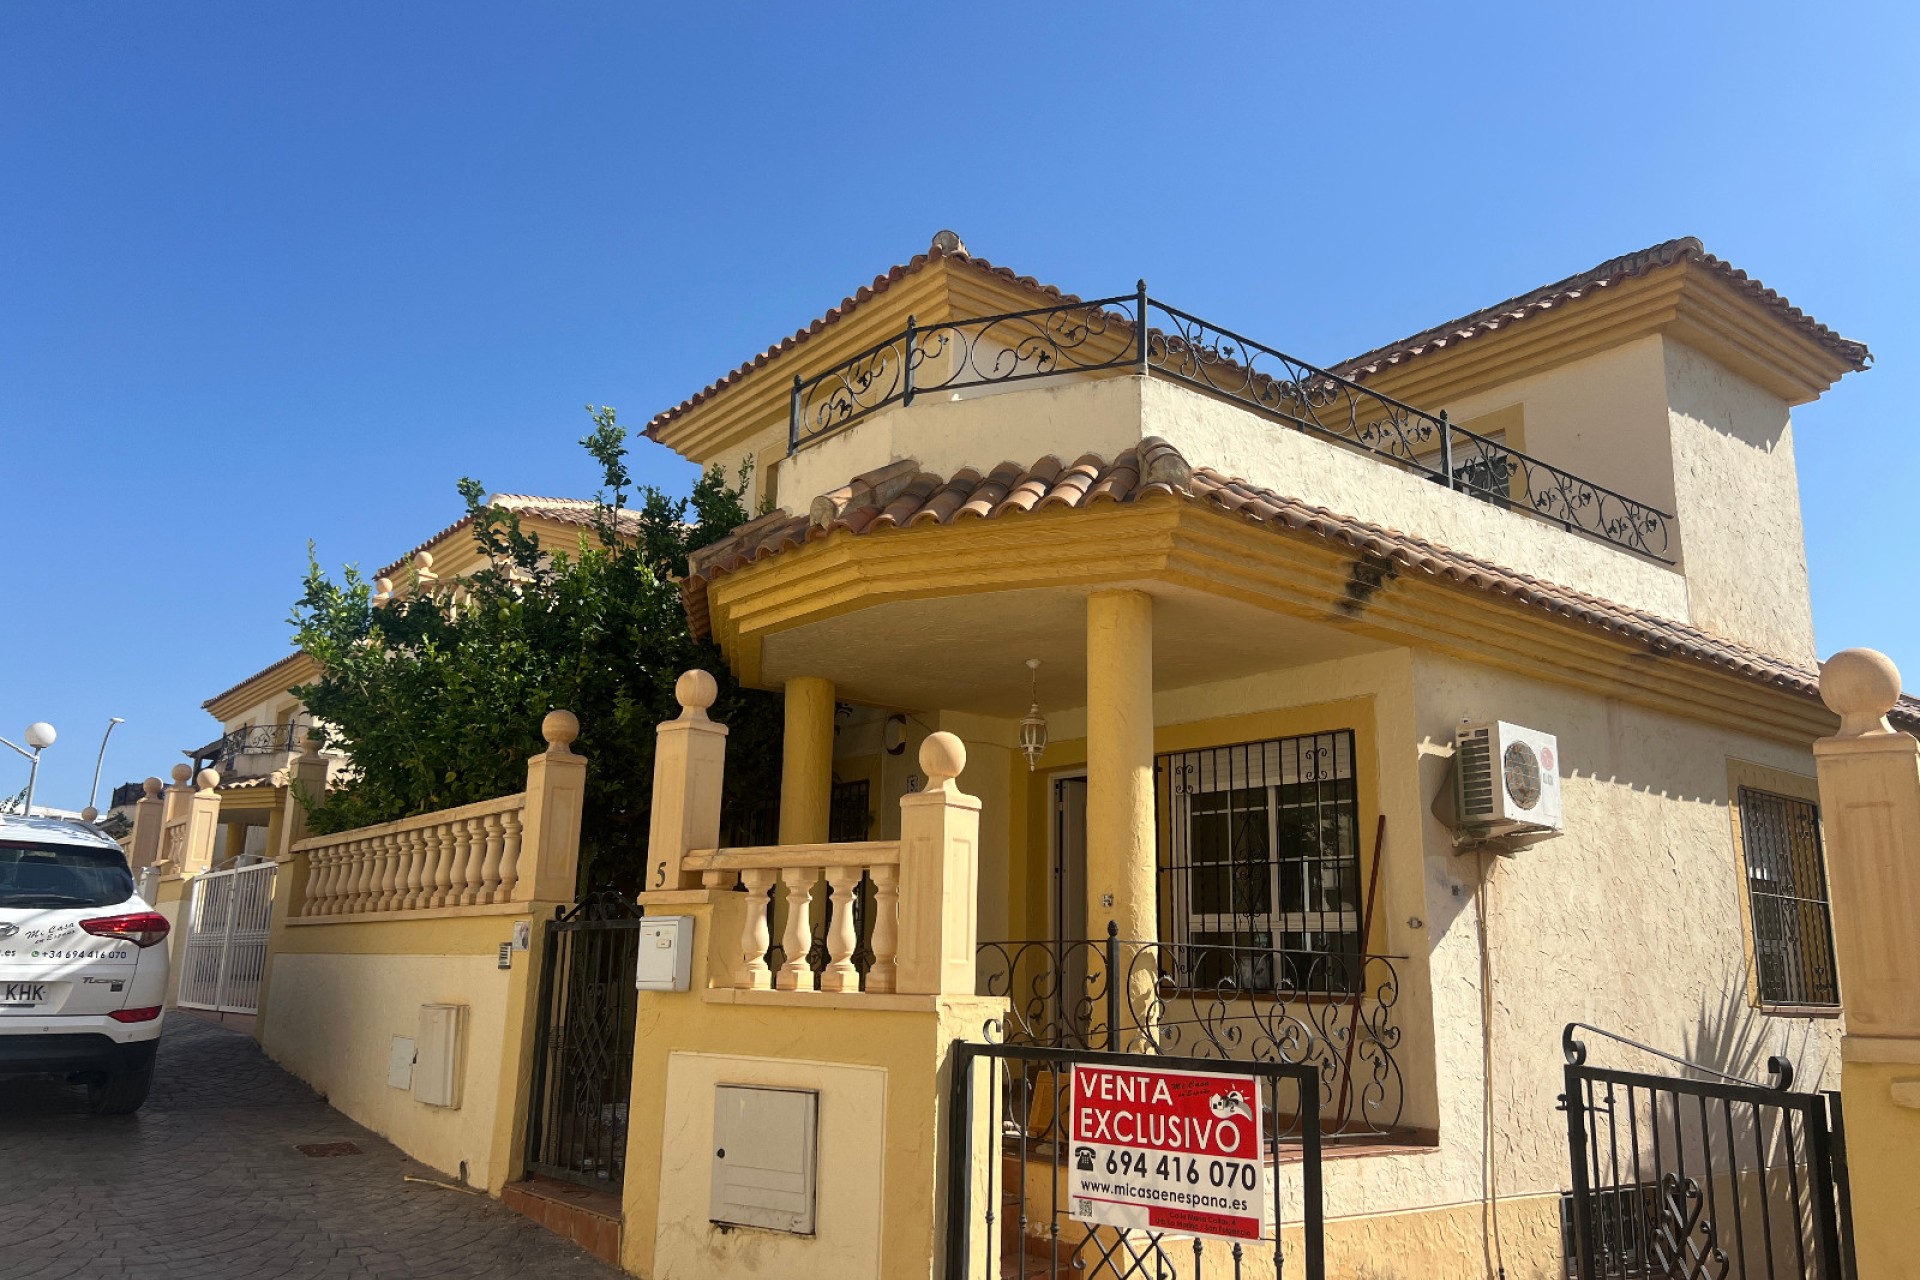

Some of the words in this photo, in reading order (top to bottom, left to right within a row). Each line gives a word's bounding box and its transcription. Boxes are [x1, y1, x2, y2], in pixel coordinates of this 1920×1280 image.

[655, 861, 667, 888] 5
[0, 949, 16, 958] .es
[42, 950, 62, 959] +34
[65, 950, 85, 959] 694
[87, 950, 106, 959] 416
[108, 950, 127, 959] 070
[5, 983, 44, 1001] KHK
[1079, 1072, 1173, 1106] VENTA
[1080, 1107, 1241, 1153] EXCLUSIVO
[1106, 1150, 1147, 1179] 694
[1156, 1154, 1199, 1185] 416
[1209, 1160, 1256, 1191] 070
[1081, 1179, 1248, 1211] www.micasaenespana.es
